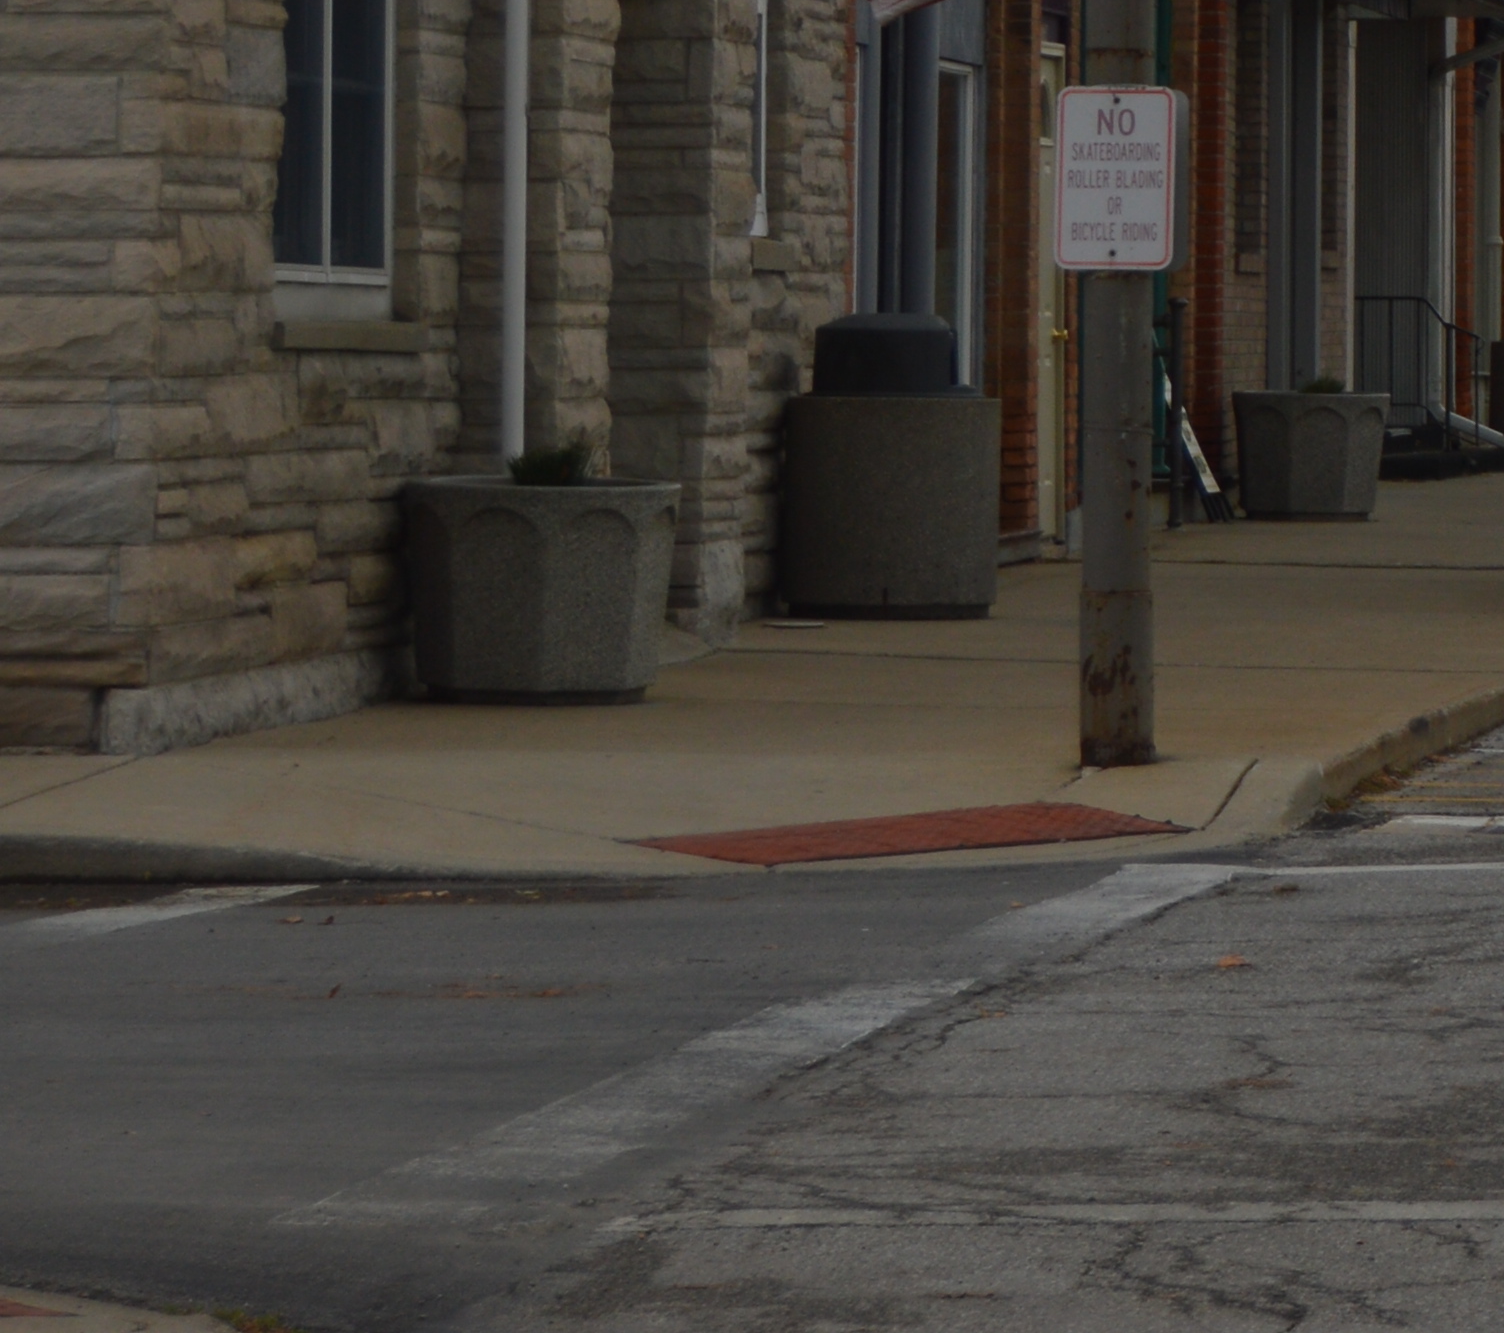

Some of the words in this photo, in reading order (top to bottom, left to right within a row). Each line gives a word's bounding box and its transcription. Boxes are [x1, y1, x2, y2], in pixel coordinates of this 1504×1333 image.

[1097, 109, 1135, 136] NO
[1071, 142, 1161, 162] SKATEBOARDING
[1067, 169, 1110, 189] ROLLER
[1115, 169, 1163, 189] BLADING
[1106, 196, 1123, 215] OR
[1071, 222, 1116, 241] BICYCLE
[1121, 222, 1158, 241] RIDING
